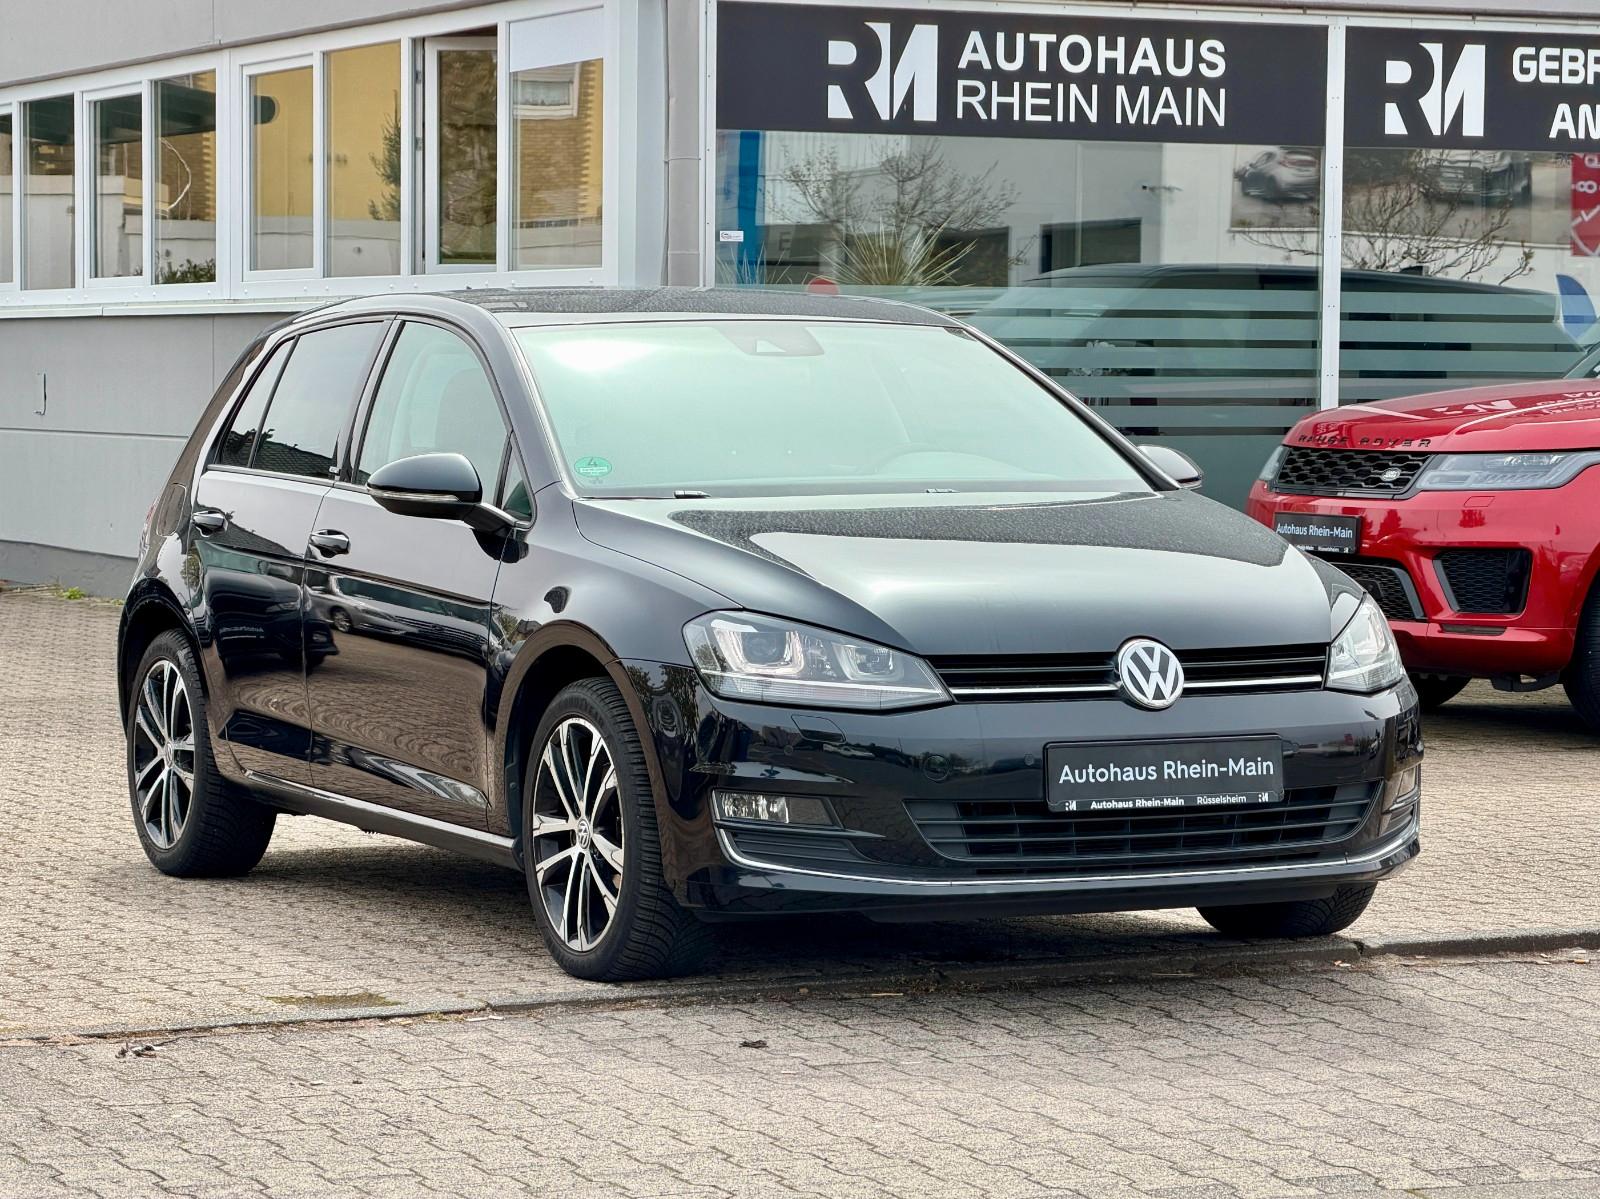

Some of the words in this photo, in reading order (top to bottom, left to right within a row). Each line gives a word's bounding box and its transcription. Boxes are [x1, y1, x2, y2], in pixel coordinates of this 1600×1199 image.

[957, 30, 1226, 78] AUTOHAUS
[956, 79, 1098, 123] RHEIN
[1115, 84, 1226, 127] MAIN
[1298, 434, 1349, 445] RANGE
[1359, 438, 1432, 448] ROVER
[1275, 522, 1308, 536] Autohaus
[1308, 524, 1353, 539] Rhein-Main
[1059, 763, 1158, 784] Autohaus
[1163, 756, 1274, 780] Rhein-Main
[1090, 799, 1134, 810] Autohaus
[1135, 796, 1185, 809] Rhein-Main
[1196, 794, 1247, 805] Rüsselsheim
